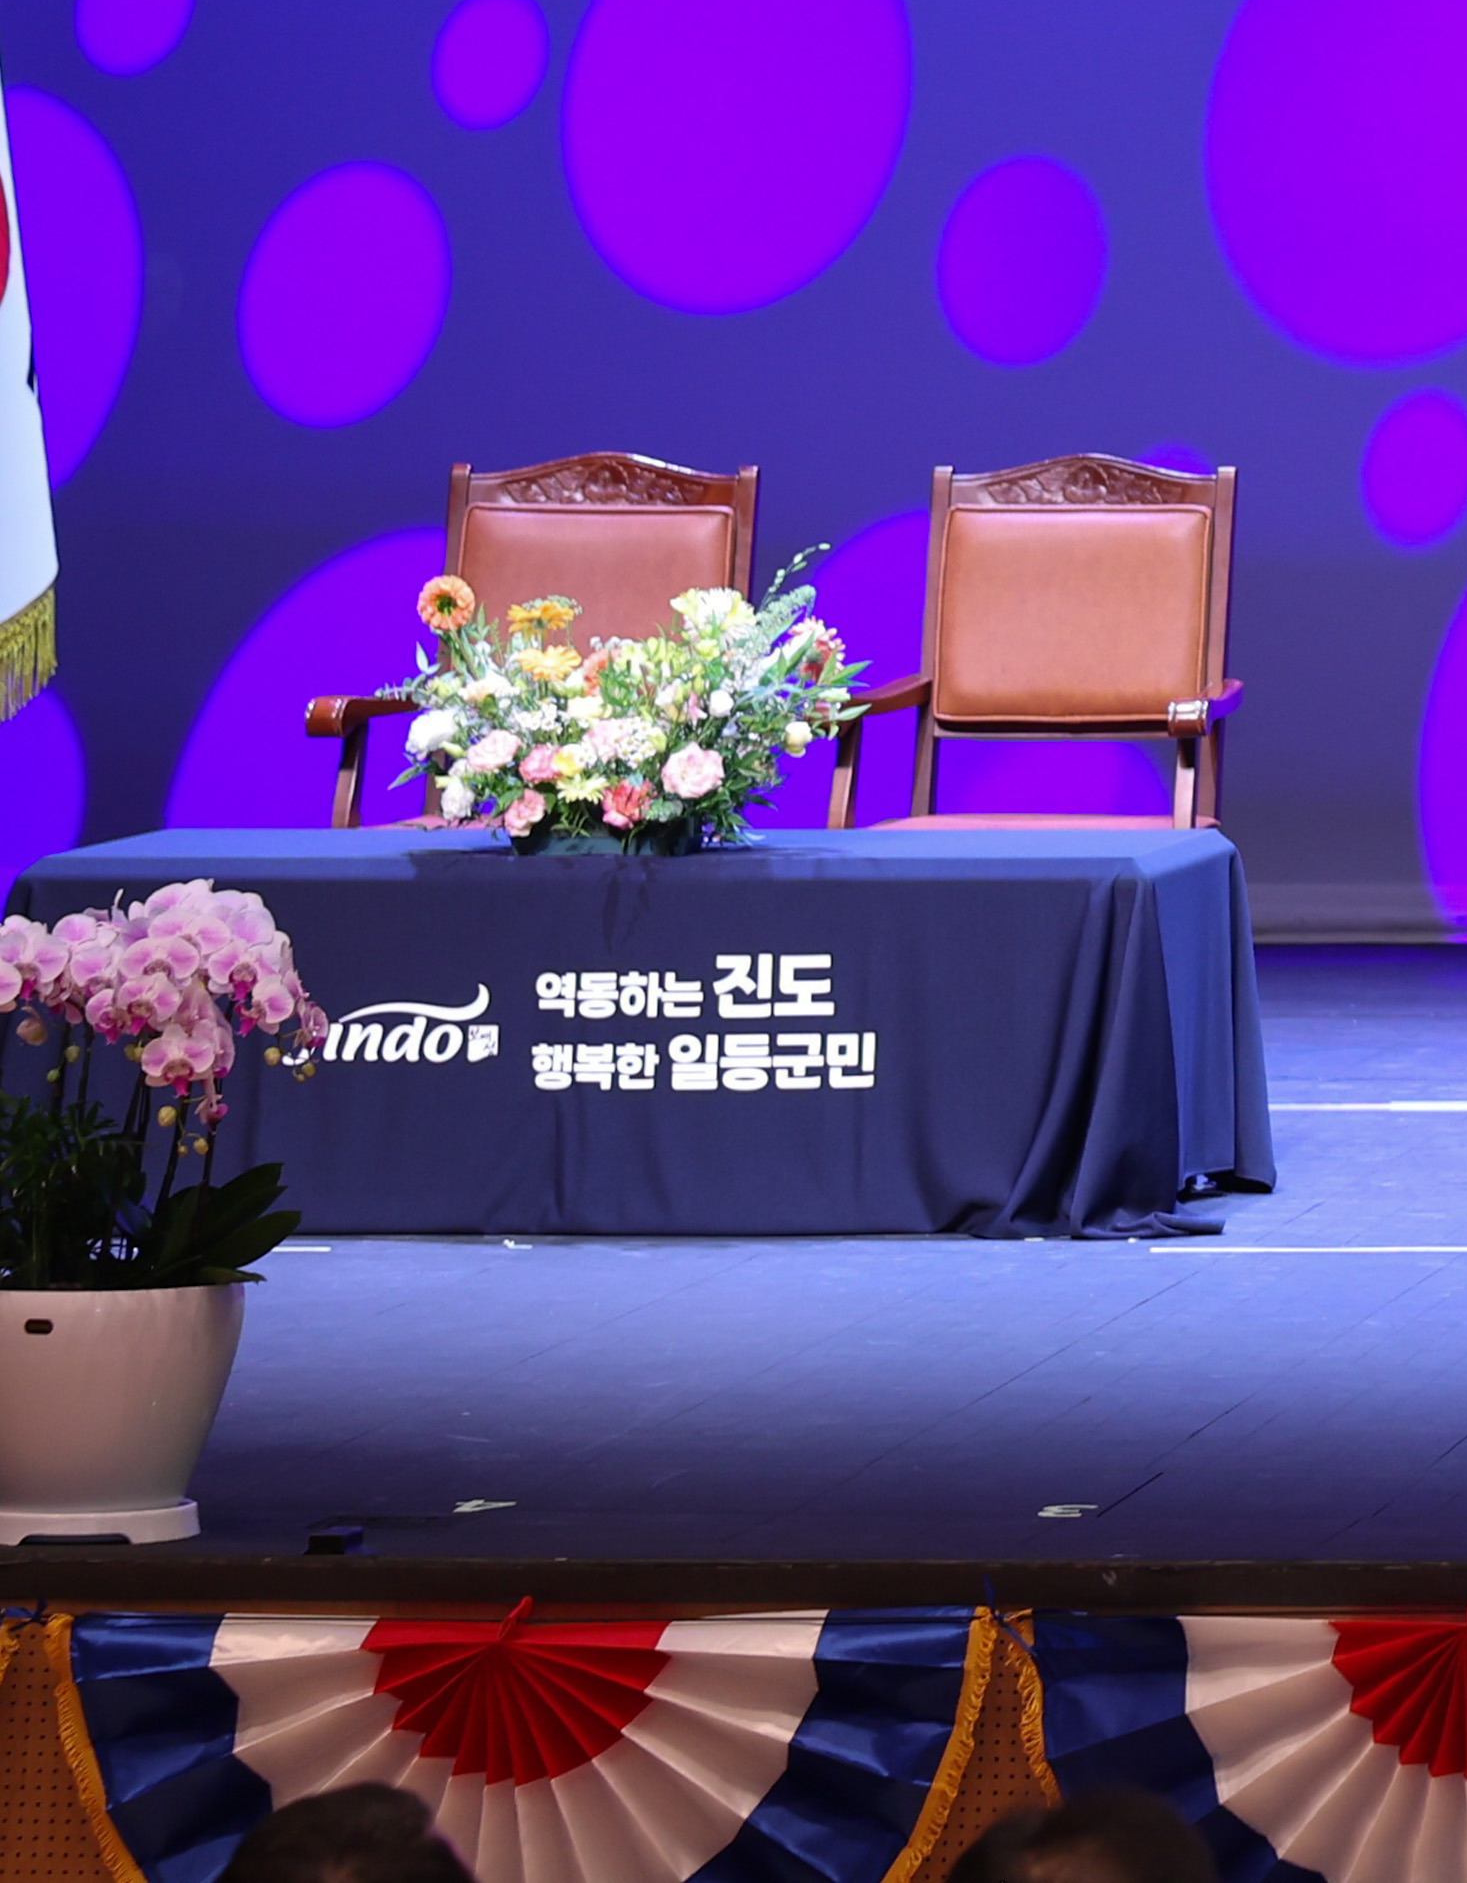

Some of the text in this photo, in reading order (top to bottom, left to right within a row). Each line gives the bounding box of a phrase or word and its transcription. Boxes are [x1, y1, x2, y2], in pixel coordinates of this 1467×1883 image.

[535, 953, 836, 1019] 역동하는 진도
[531, 1042, 660, 1091] 행복한
[668, 1031, 876, 1091] 일등군민
